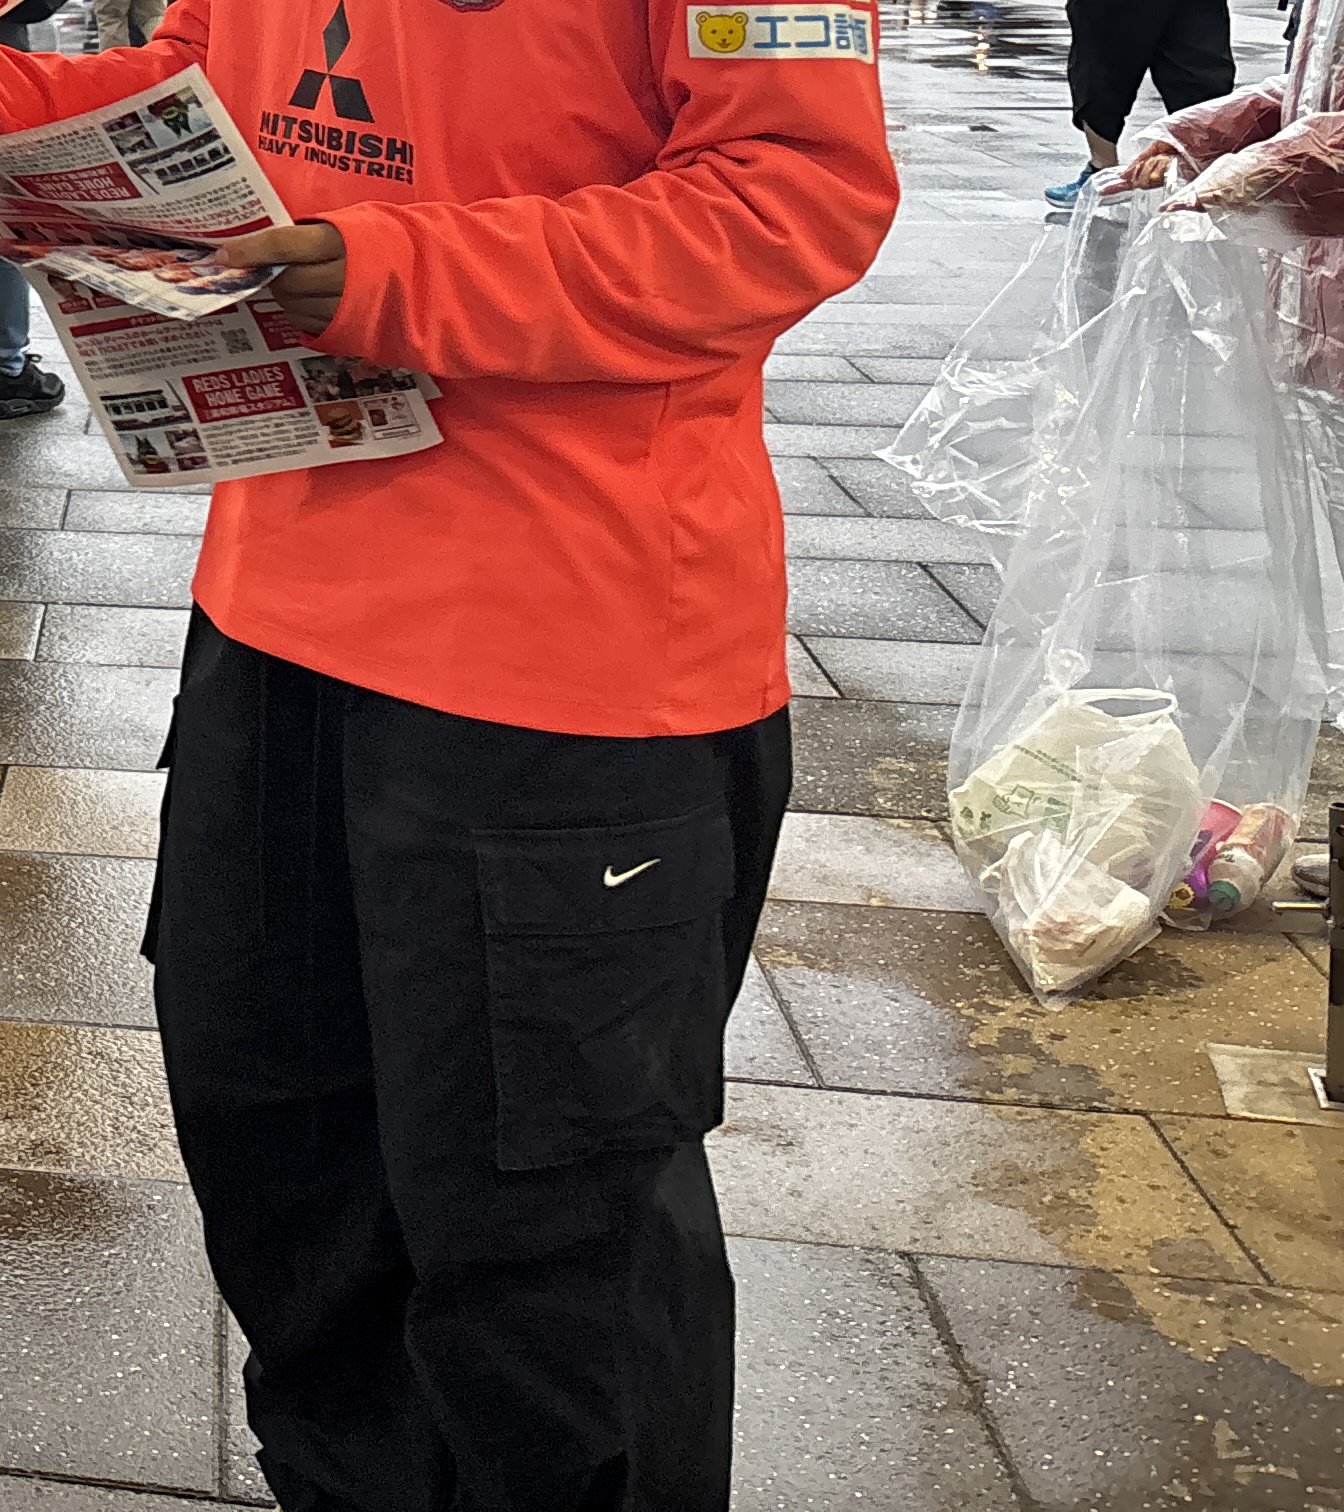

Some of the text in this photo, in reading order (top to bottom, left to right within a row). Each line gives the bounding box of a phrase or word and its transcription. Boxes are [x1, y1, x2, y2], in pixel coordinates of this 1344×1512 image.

[304, 146, 414, 186] INDUSTRIES
[231, 366, 285, 387] LADIES
[204, 382, 286, 407] HOME GAME
